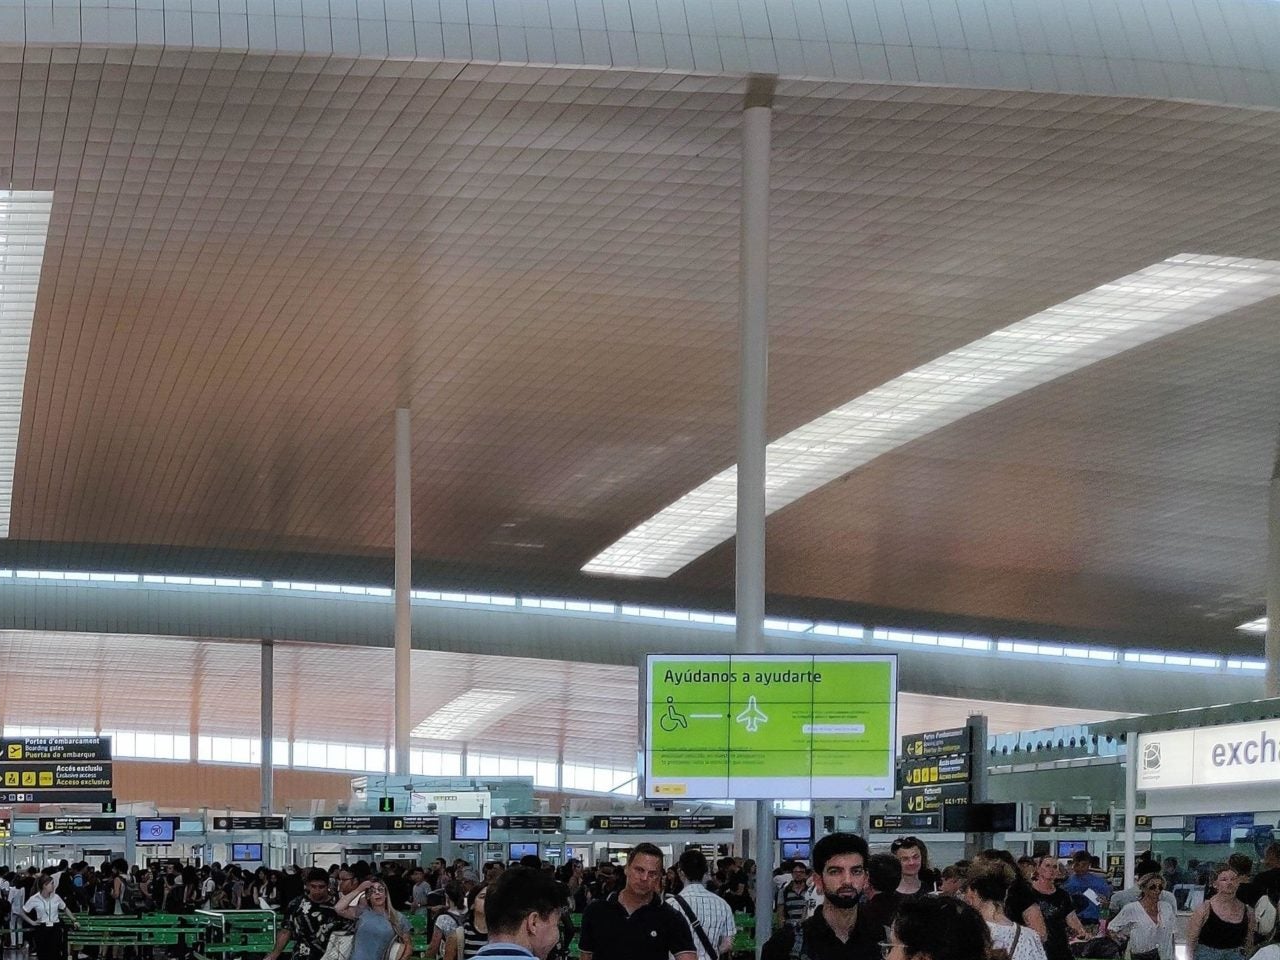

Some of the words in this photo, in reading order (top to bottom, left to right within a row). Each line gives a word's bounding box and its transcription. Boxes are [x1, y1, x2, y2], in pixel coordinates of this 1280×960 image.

[664, 669, 737, 685] Ayúdanos
[742, 672, 751, 683] a
[755, 669, 822, 685] ayudarte
[1211, 730, 1280, 767] exch
